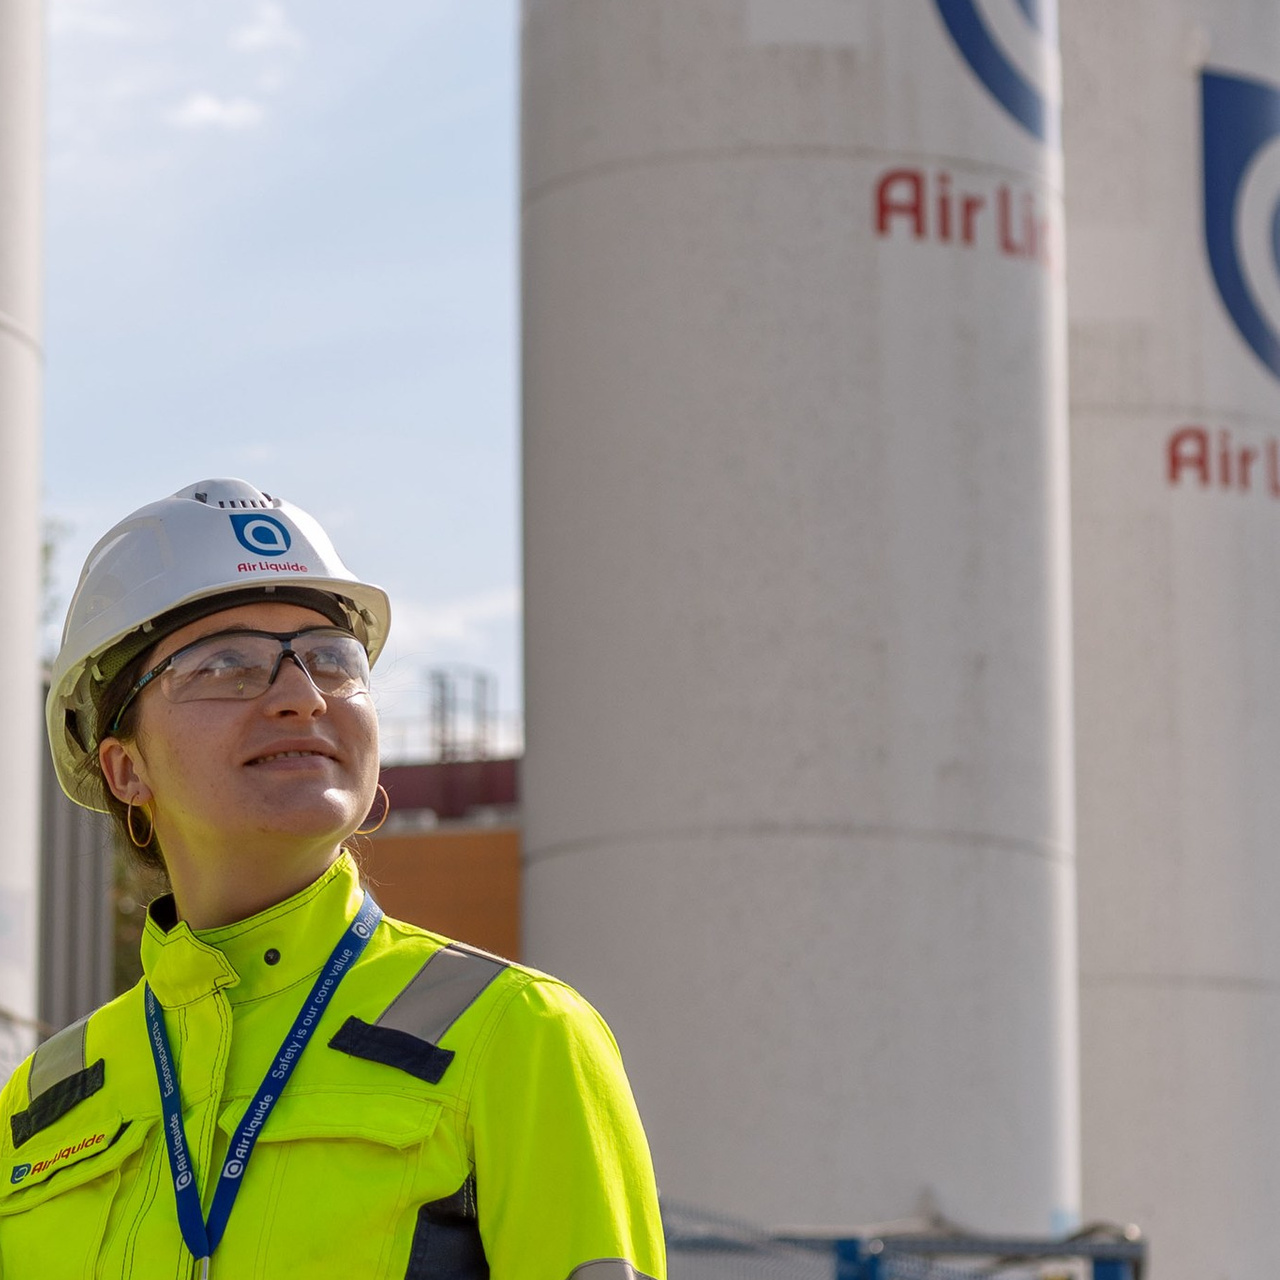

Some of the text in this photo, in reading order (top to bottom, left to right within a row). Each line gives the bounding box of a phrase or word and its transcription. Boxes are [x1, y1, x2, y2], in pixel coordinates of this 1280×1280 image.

[873, 167, 987, 248] Air
[1165, 425, 1262, 492] Air
[237, 561, 309, 573] Air Liquide
[271, 948, 354, 1079] Safety is our core value
[152, 1021, 174, 1098] Безопасность
[30, 1133, 106, 1176] Air Liquide
[170, 1112, 188, 1172] Air Liquide
[235, 1094, 274, 1159] Air Liquide
